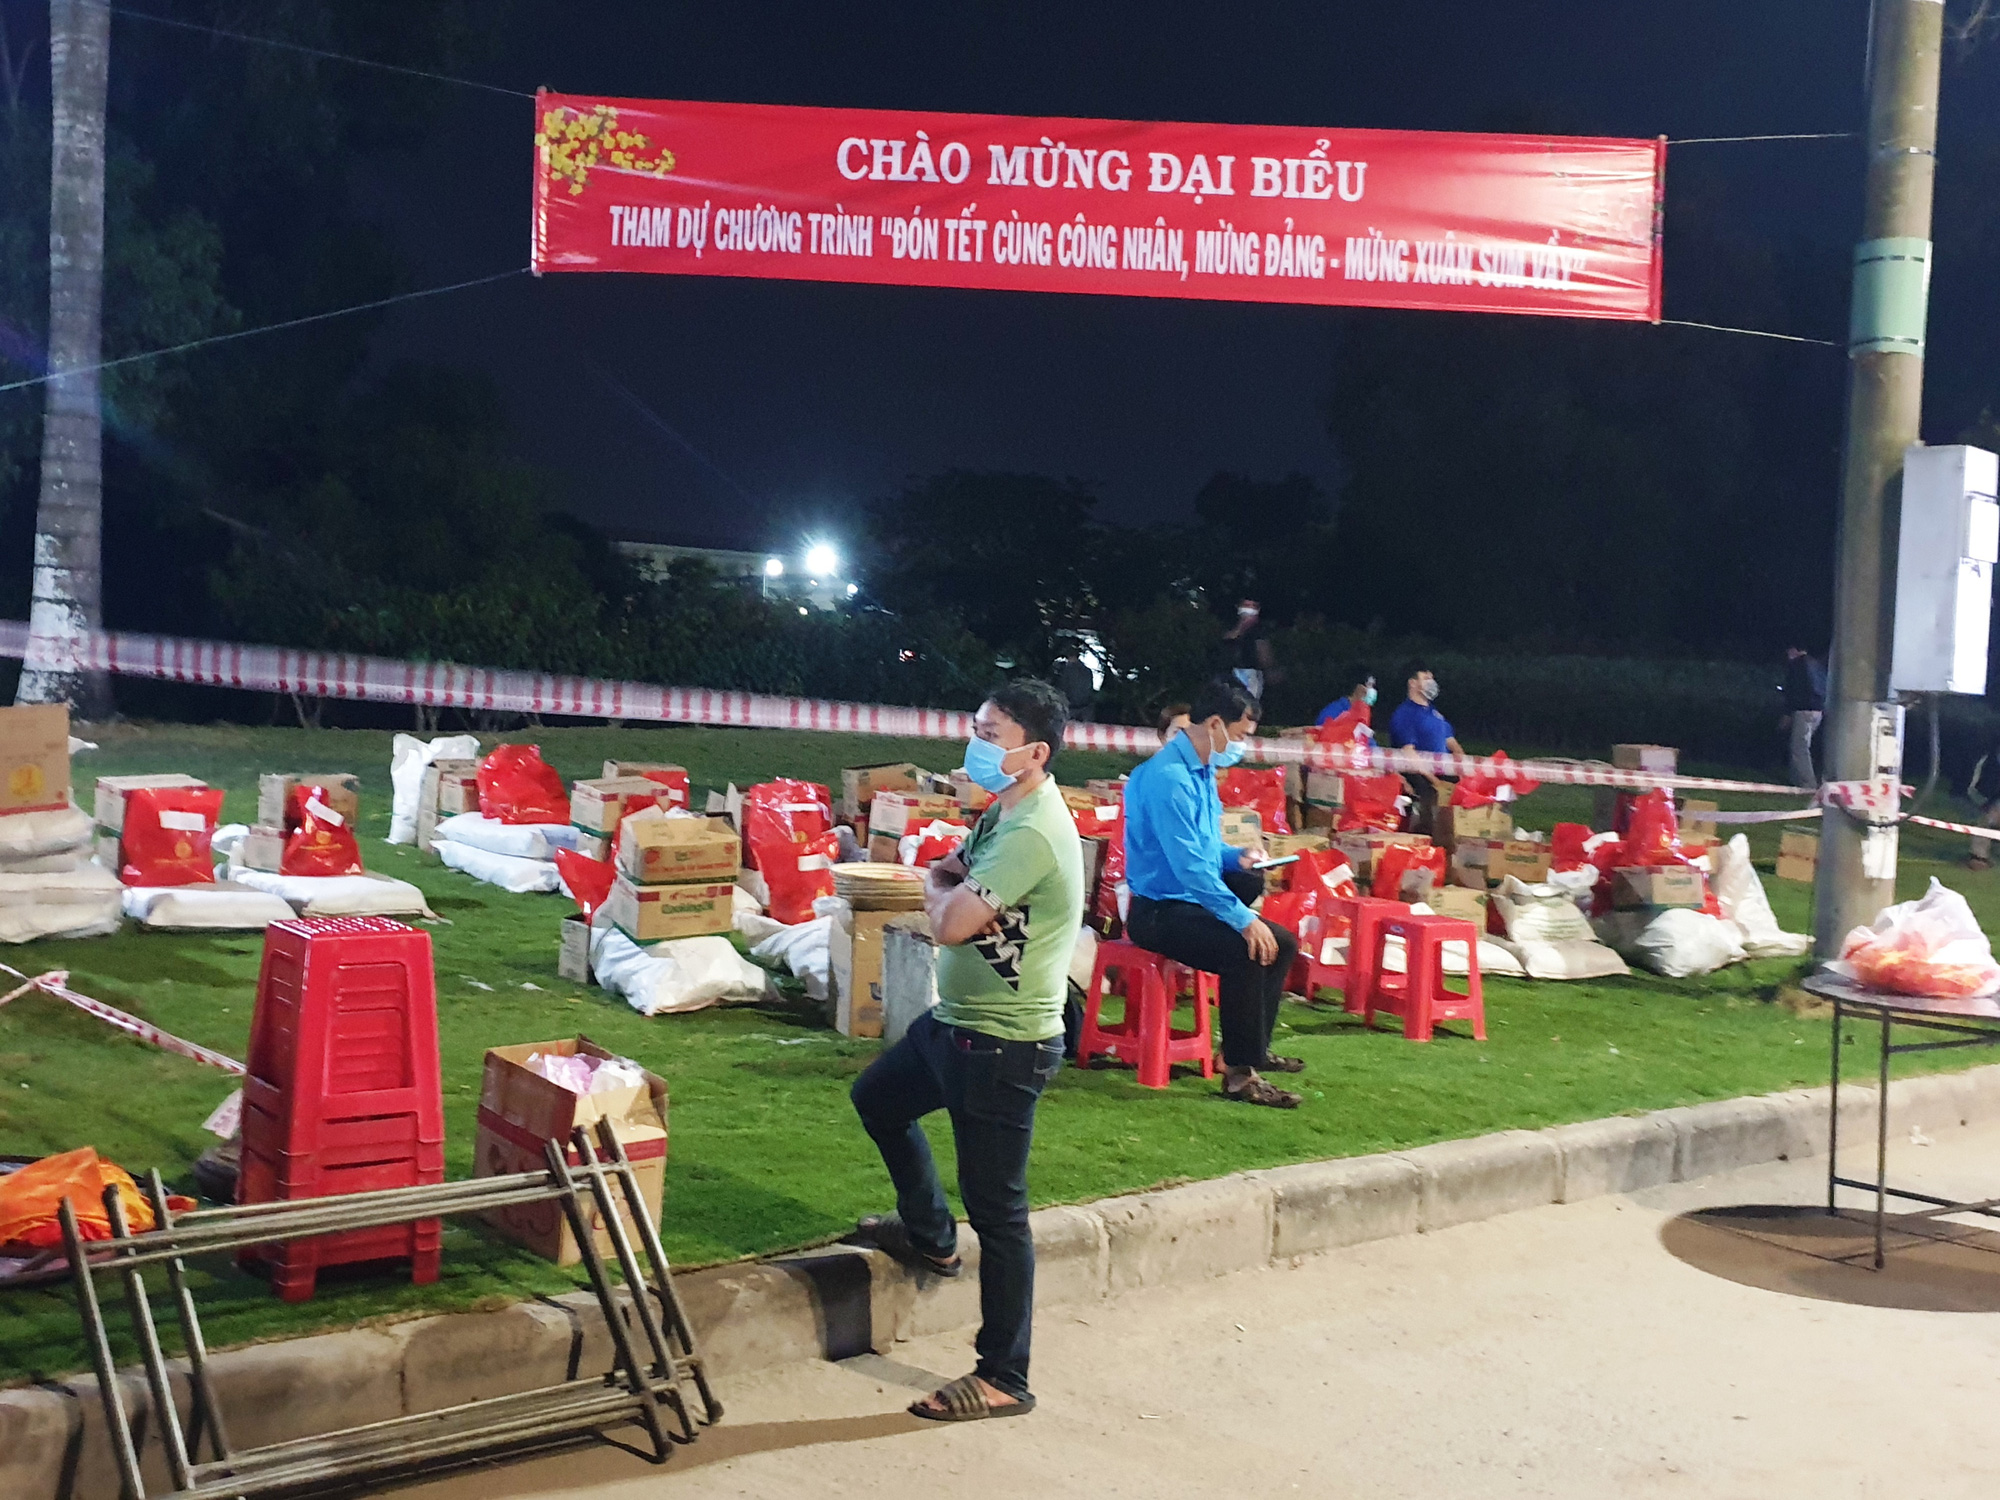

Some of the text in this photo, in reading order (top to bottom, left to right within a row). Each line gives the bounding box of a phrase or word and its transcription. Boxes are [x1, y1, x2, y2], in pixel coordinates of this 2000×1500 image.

[837, 130, 1368, 205] CHÀO MỪNG ĐẠI BIỂU
[609, 205, 672, 248] THAM
[677, 200, 711, 258] DỰ
[714, 203, 803, 254] CHƯƠNG
[807, 204, 874, 257] TRÌNH
[945, 203, 988, 263] TẾT
[993, 209, 1054, 267] CÙNG
[1058, 213, 1118, 269] CÔNG
[1122, 217, 1189, 281] NHÂN,
[1195, 219, 1261, 277] MỪNG
[1264, 217, 1327, 280] ĐẢNG
[1344, 226, 1411, 284] MỪNG
[1412, 230, 1474, 286] XUÂN
